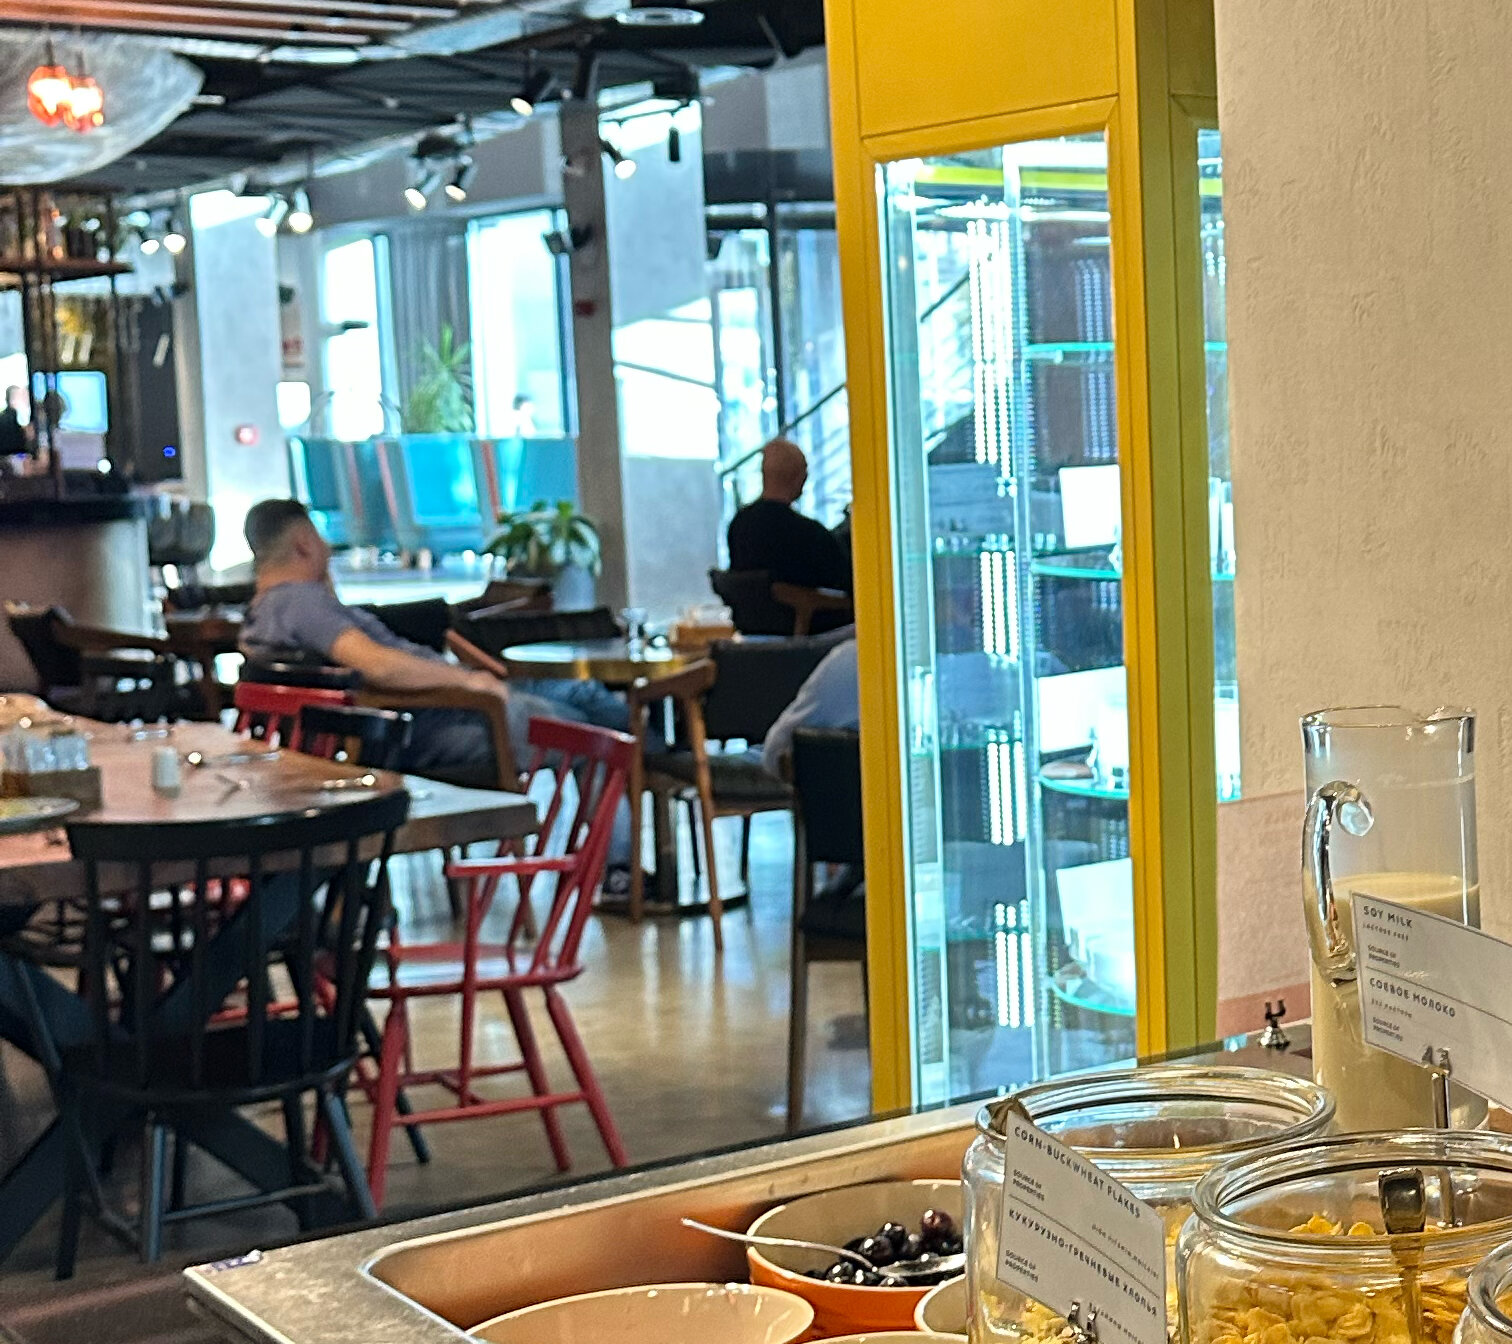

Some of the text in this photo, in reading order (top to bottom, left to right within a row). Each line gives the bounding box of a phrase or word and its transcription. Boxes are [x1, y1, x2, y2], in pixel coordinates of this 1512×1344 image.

[1363, 905, 1412, 928] SOY MILK
[1413, 992, 1456, 1018] МОЛОКО
[1014, 1126, 1141, 1219] CORN-BUCKWHEAT FLAKES
